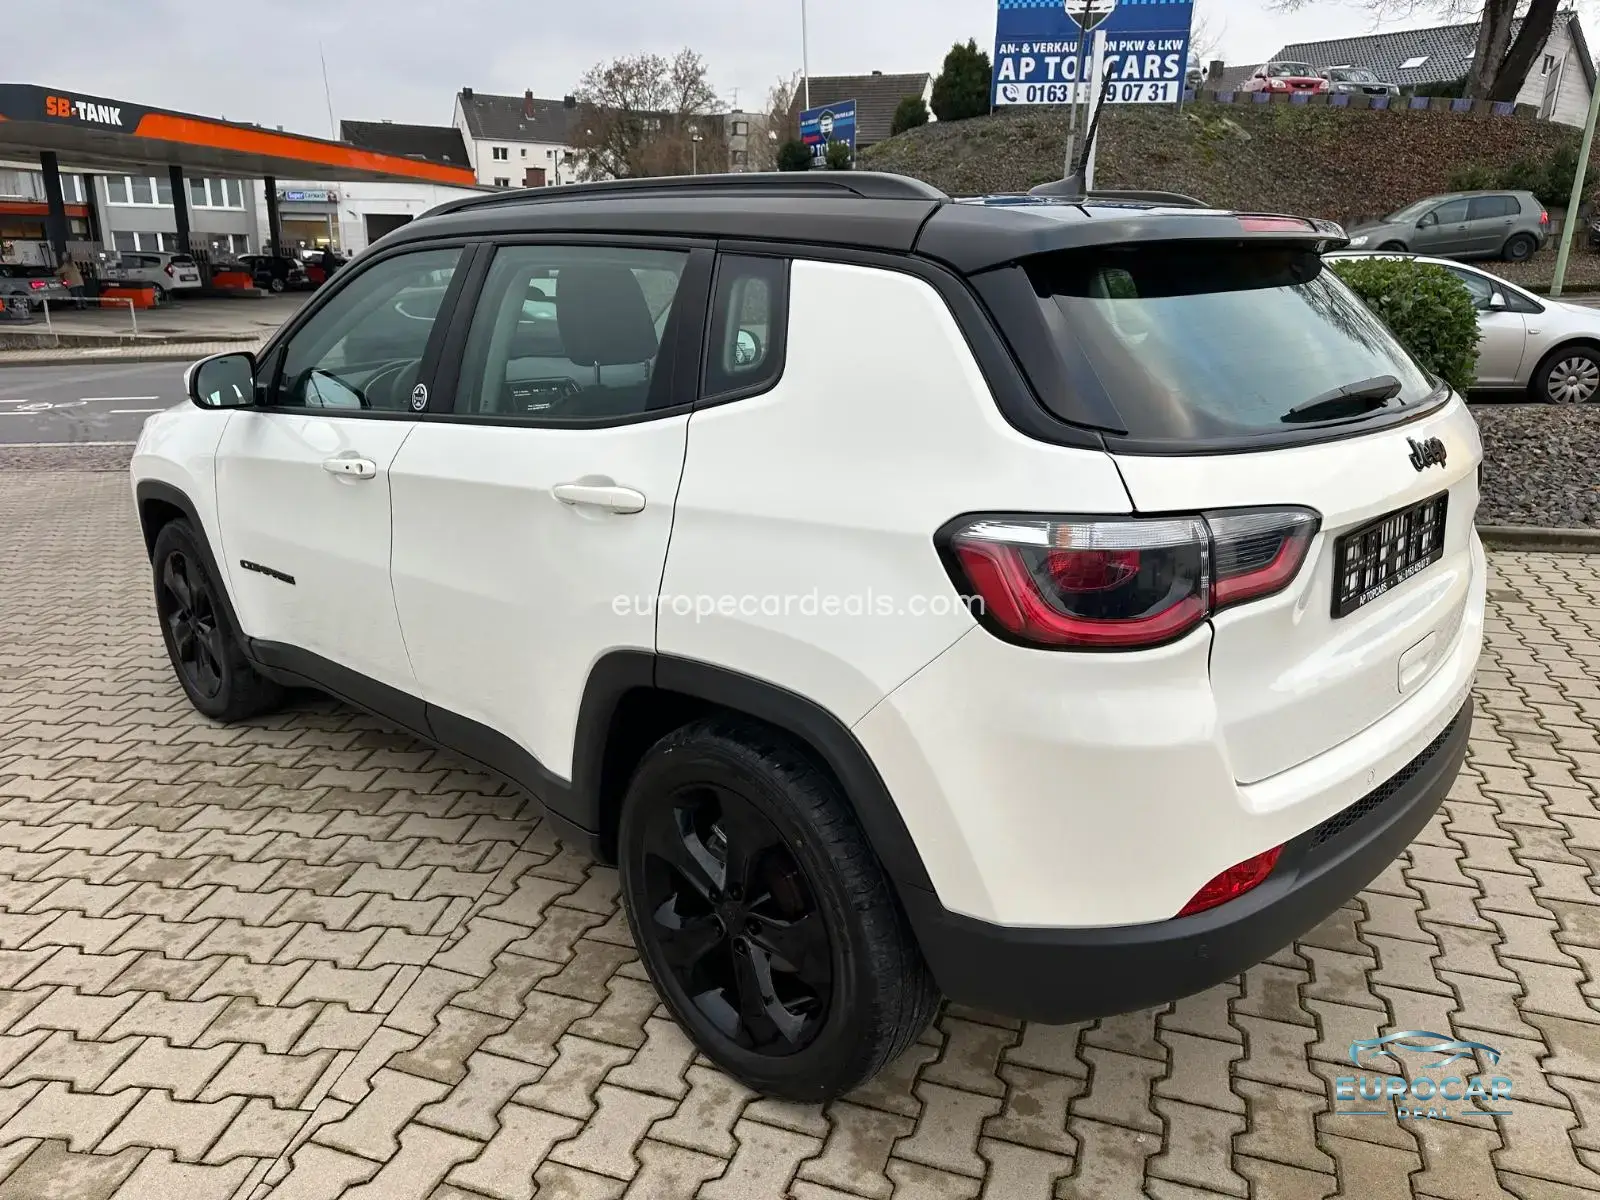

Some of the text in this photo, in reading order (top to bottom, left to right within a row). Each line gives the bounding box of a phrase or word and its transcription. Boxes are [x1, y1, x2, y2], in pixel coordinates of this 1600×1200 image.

[999, 44, 1019, 54] AN-
[1022, 43, 1031, 53] &
[1032, 42, 1082, 53] VERKAU
[1120, 41, 1144, 51] PKW
[1147, 40, 1155, 50] &
[1158, 40, 1184, 50] LKW
[998, 57, 1035, 80] AP
[1026, 84, 1067, 102] 0163
[1122, 84, 1144, 101] 07
[1148, 83, 1168, 101] 31
[46, 96, 122, 126] SB-TANK
[1406, 436, 1447, 472] Jeep
